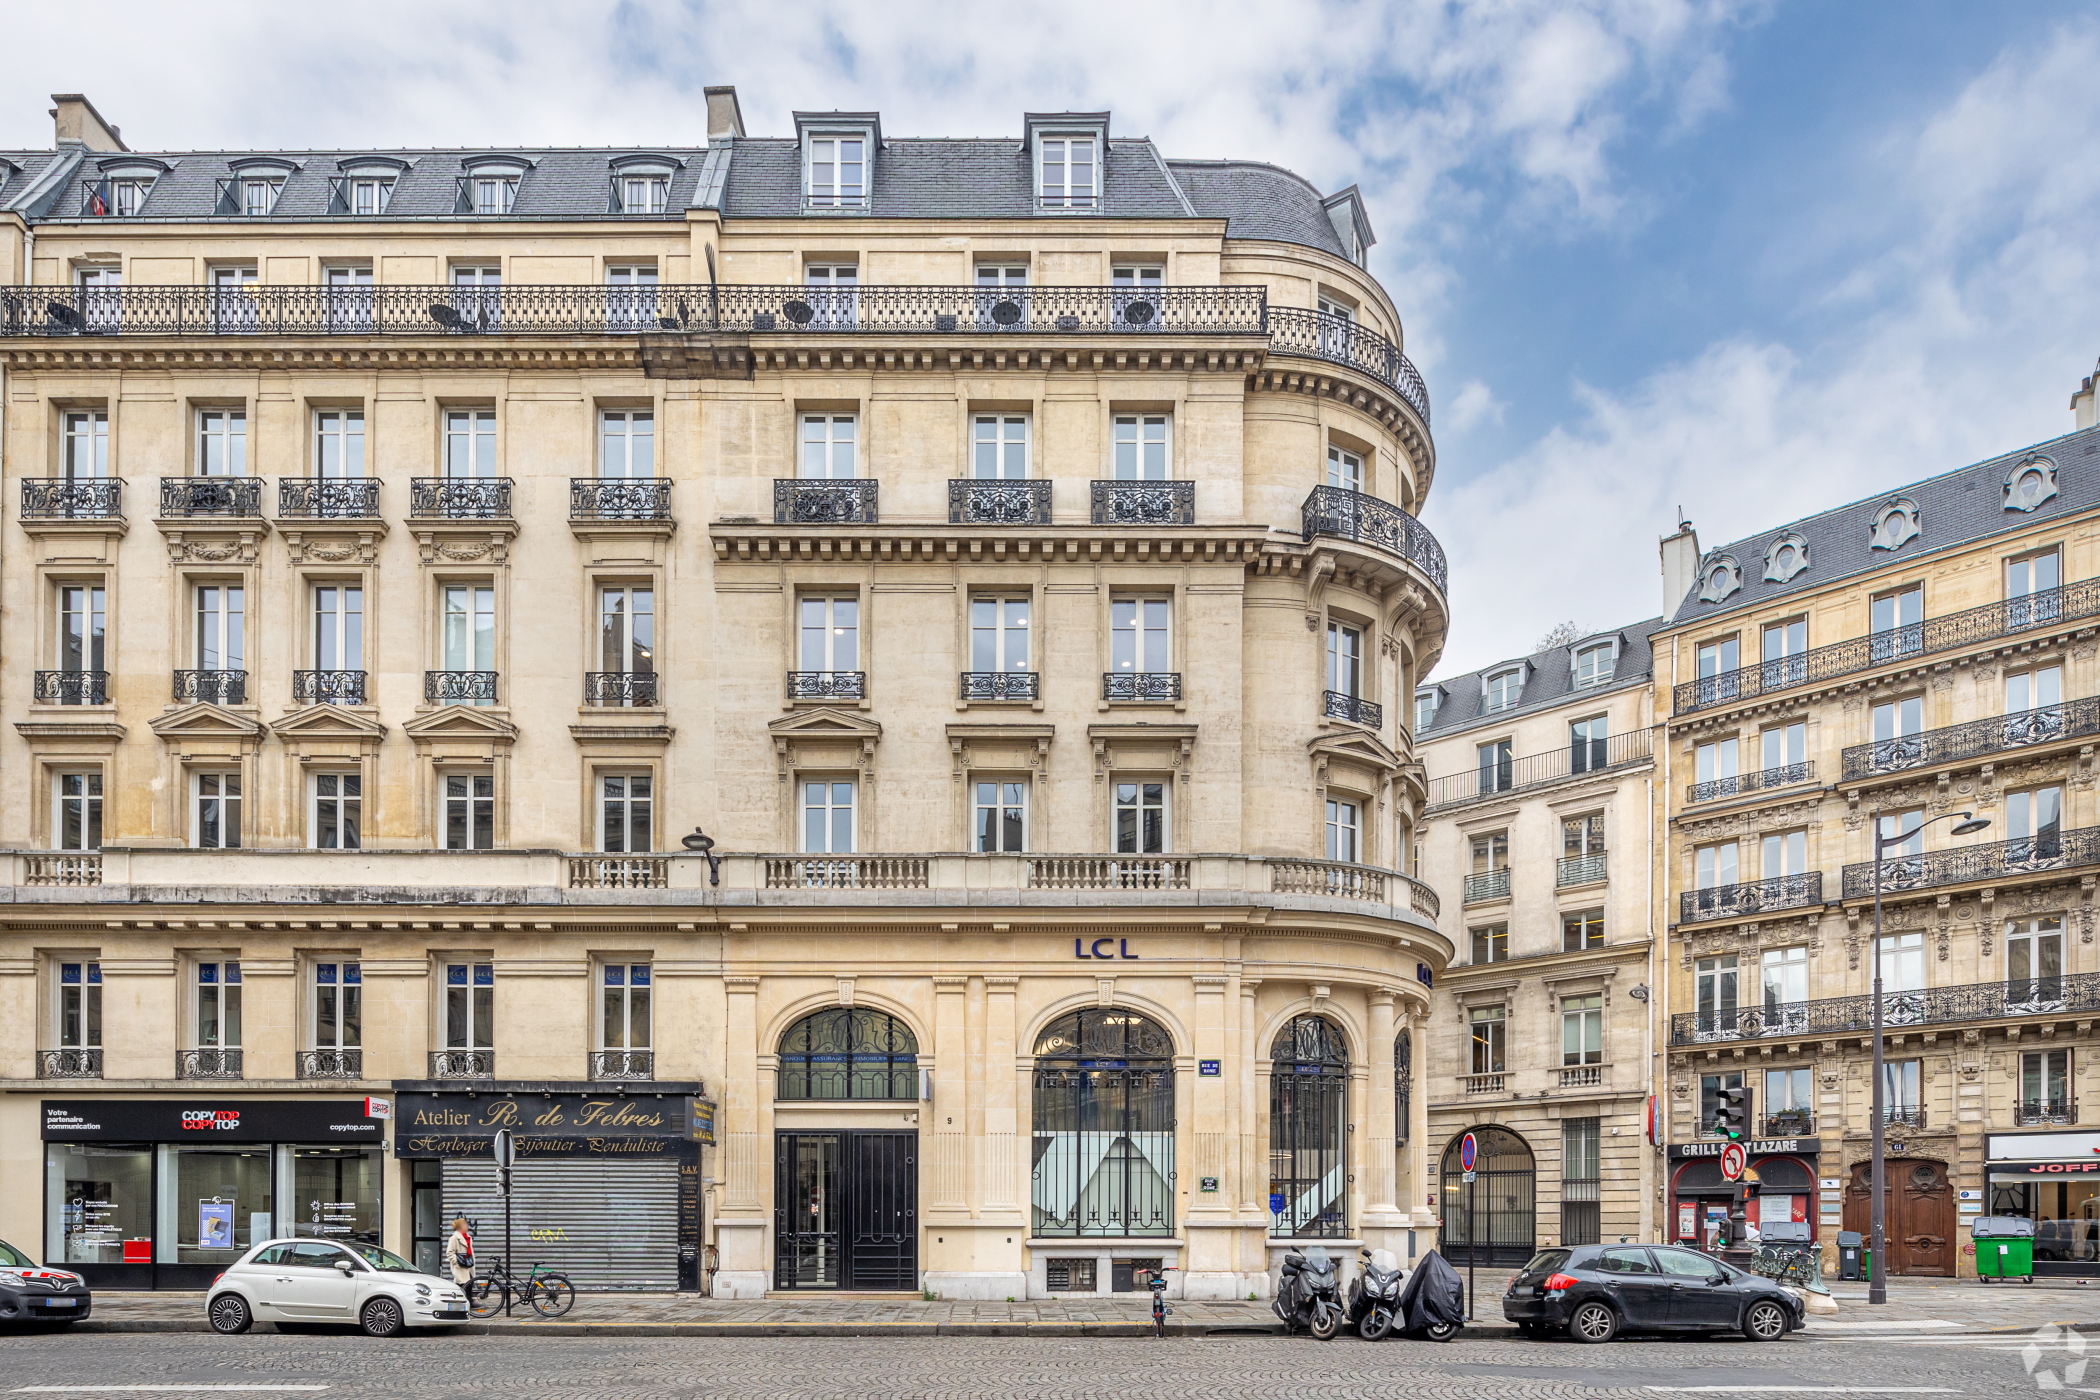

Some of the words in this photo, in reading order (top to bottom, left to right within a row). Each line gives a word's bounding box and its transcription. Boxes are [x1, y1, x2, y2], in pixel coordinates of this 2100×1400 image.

[1075, 938, 1139, 959] LCL
[181, 1110, 240, 1121] COPYTOP
[413, 1108, 471, 1126] Atelier
[478, 1100, 523, 1126] R.
[534, 1104, 565, 1126] de
[573, 1101, 664, 1126] Febres
[47, 1116, 84, 1124] partenaire
[181, 1120, 240, 1130] COPYTOP
[947, 1116, 953, 1125] 9
[329, 1124, 376, 1132] copytop.com
[408, 1134, 487, 1157] Horloger
[513, 1135, 576, 1156] Bijoutier
[586, 1137, 665, 1152] Penduliste
[1682, 1144, 1718, 1156] GRILL
[1753, 1140, 1798, 1153] LAZARE
[2028, 1163, 2100, 1173] JOFF
